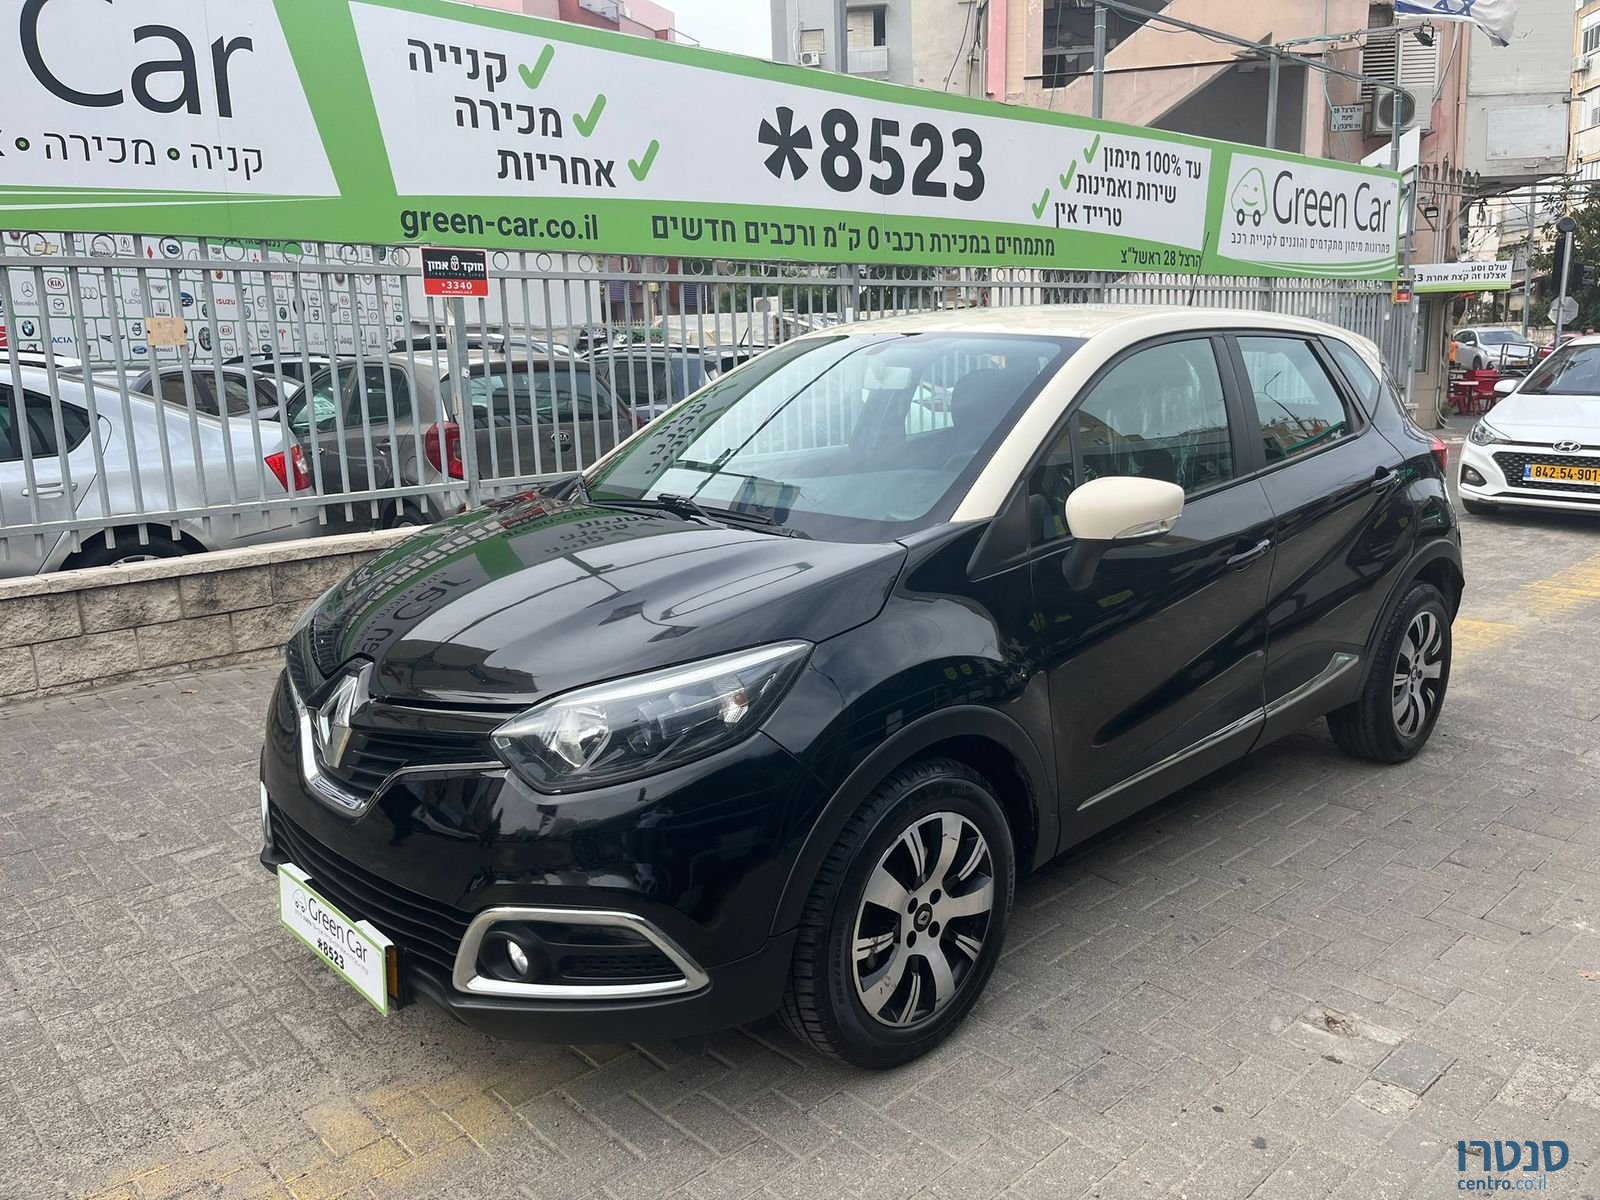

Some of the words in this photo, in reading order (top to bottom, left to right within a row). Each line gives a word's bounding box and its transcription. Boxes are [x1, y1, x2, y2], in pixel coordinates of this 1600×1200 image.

[20, 0, 253, 118] Car
[407, 38, 507, 93] קנייה
[454, 95, 563, 138] מכירה
[44, 132, 156, 165] מכירה
[1104, 147, 1140, 172] מימון
[190, 143, 263, 180] קניה
[497, 149, 617, 188] אחריות
[1145, 151, 1182, 177] 100%
[1185, 159, 1201, 179] עד
[1076, 173, 1132, 199] ואמינות
[1136, 181, 1176, 204] שירות
[1273, 170, 1347, 229] Green
[1354, 182, 1391, 232] Car
[400, 209, 599, 240] green-car.co.il
[1055, 202, 1077, 228] אין
[1083, 205, 1122, 227] טרייד
[652, 215, 737, 242] חדשים
[745, 221, 816, 247] ורכבים
[867, 225, 879, 250] 0
[1231, 232, 1247, 245] רכב
[884, 231, 925, 252] רכבי
[930, 233, 990, 254] במכירת
[996, 236, 1055, 256] מתמחים
[1250, 233, 1277, 248] לקניית
[1310, 238, 1342, 253] מתקדמים
[1345, 241, 1363, 253] מימון
[427, 260, 449, 271] אמון
[461, 261, 485, 273] מוקד
[1163, 249, 1176, 266] 28
[1178, 250, 1201, 268] הרצל
[1487, 263, 1507, 271] שלם
[1451, 273, 1469, 282] קצת
[51, 336, 73, 344] ACIA
[308, 897, 344, 944] Green
[347, 929, 368, 963] Car
